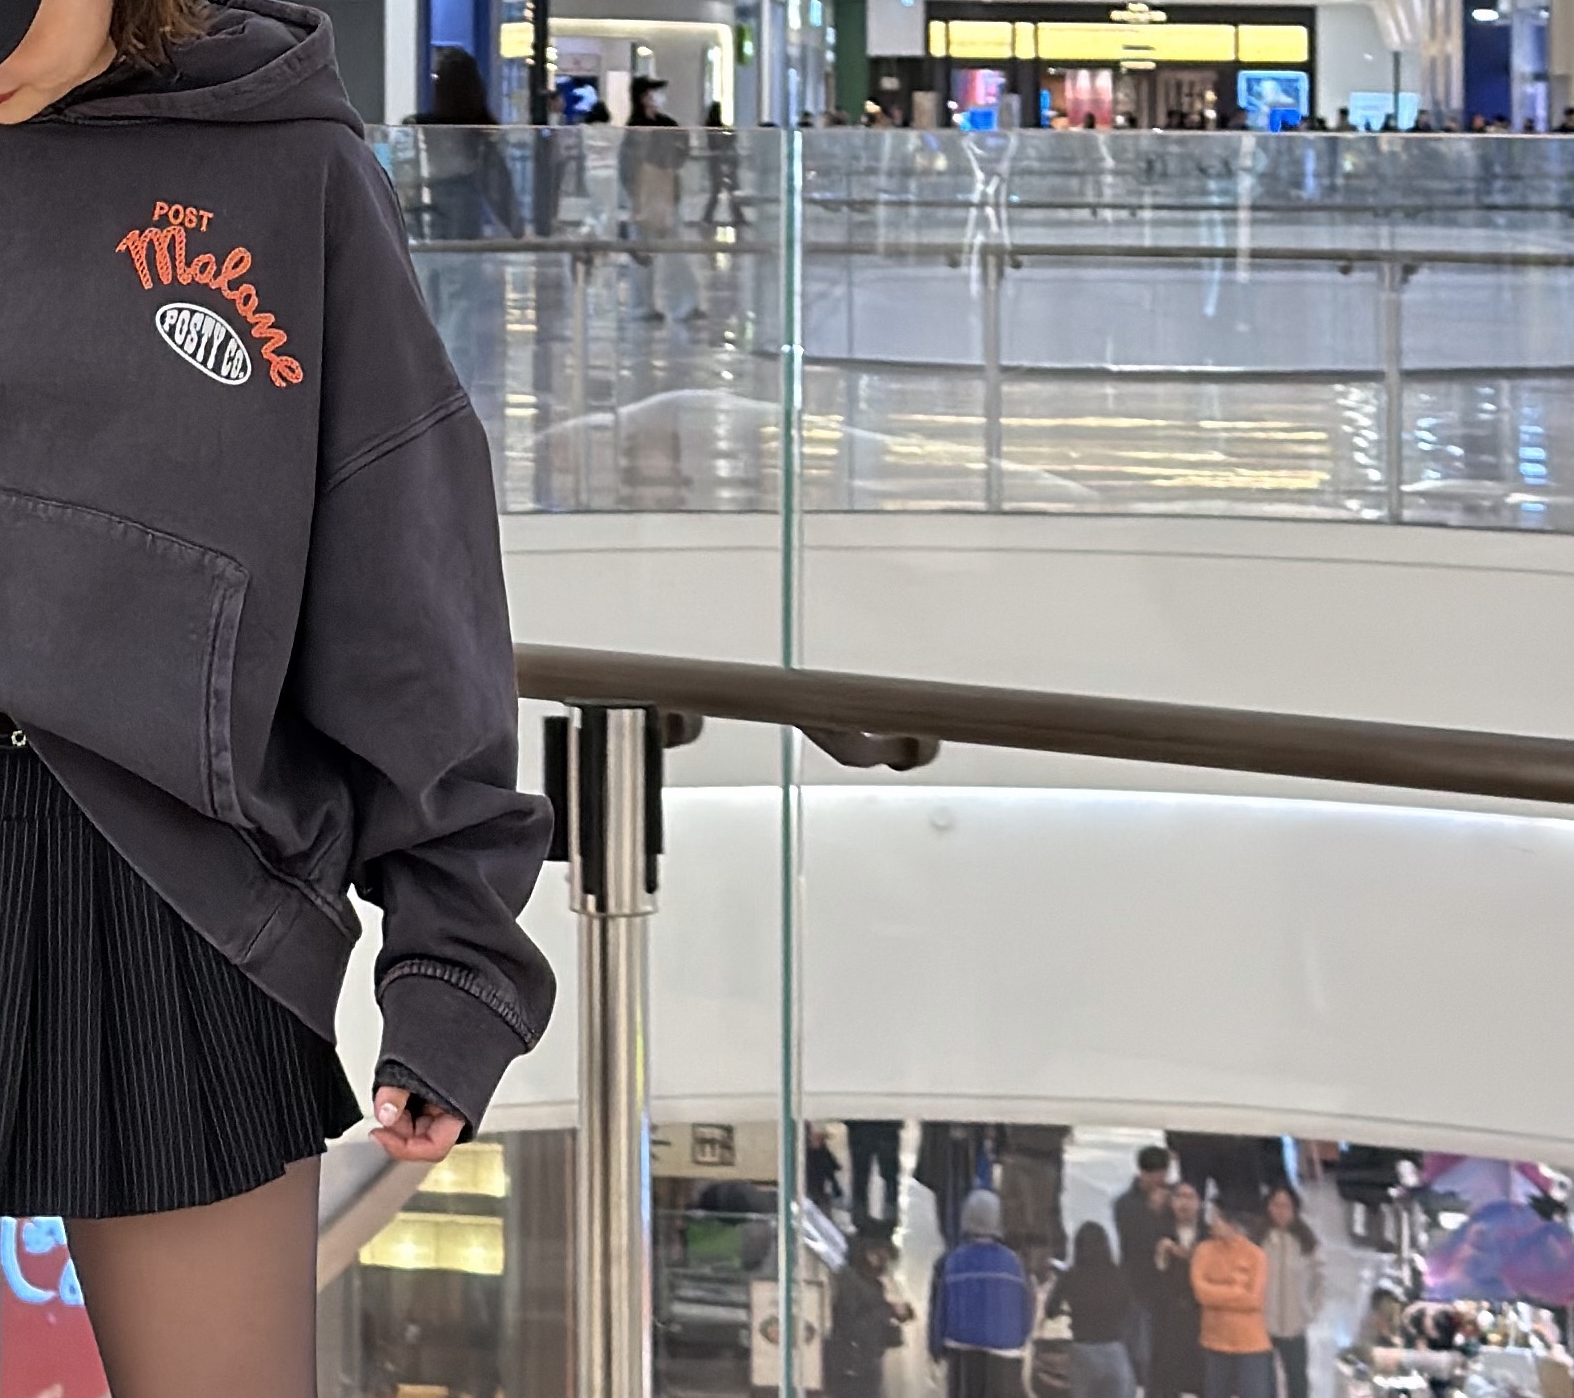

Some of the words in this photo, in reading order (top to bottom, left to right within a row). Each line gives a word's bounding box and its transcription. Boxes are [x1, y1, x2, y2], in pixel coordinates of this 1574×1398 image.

[152, 201, 214, 232] POST
[115, 225, 304, 388] Malone
[163, 309, 226, 370] POSTY
[221, 337, 245, 379] CO.
